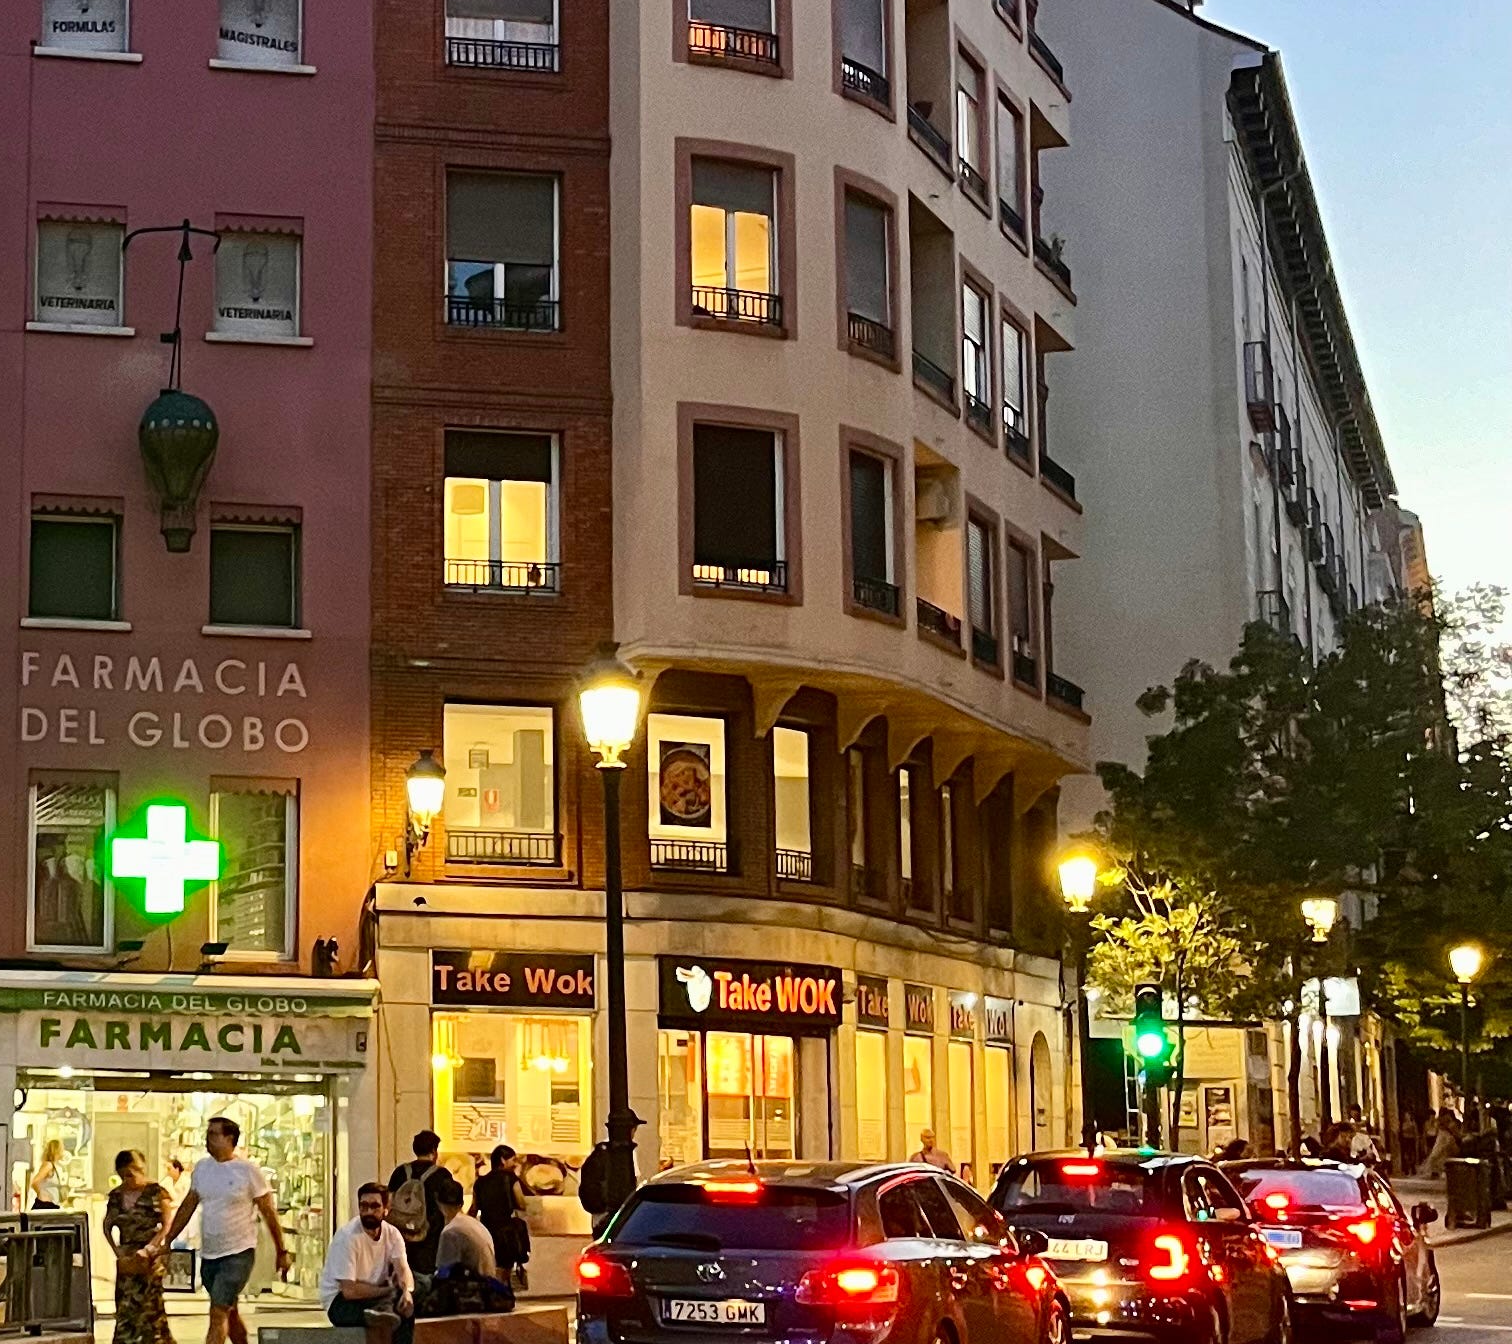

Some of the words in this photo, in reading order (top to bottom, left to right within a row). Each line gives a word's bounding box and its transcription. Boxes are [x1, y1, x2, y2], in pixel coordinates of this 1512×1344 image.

[52, 20, 116, 33] FORMULAS
[219, 27, 298, 53] MAGISTRALES
[40, 296, 116, 311] VETERINARIA
[218, 307, 293, 322] VETERINARIA
[21, 652, 307, 698] FARMACIA
[21, 707, 105, 745] DEL
[127, 711, 310, 754] GLOBO
[434, 964, 511, 993] Take
[524, 967, 594, 996] Wok
[714, 970, 772, 1012] Take
[775, 974, 837, 1016] WOK
[43, 991, 163, 1010] FARMACIA
[172, 994, 216, 1011] DEL
[226, 996, 307, 1014] GLOBO
[39, 1017, 302, 1055] FARMACIA
[674, 1302, 719, 1321] 7253
[725, 1304, 759, 1323] GMK
